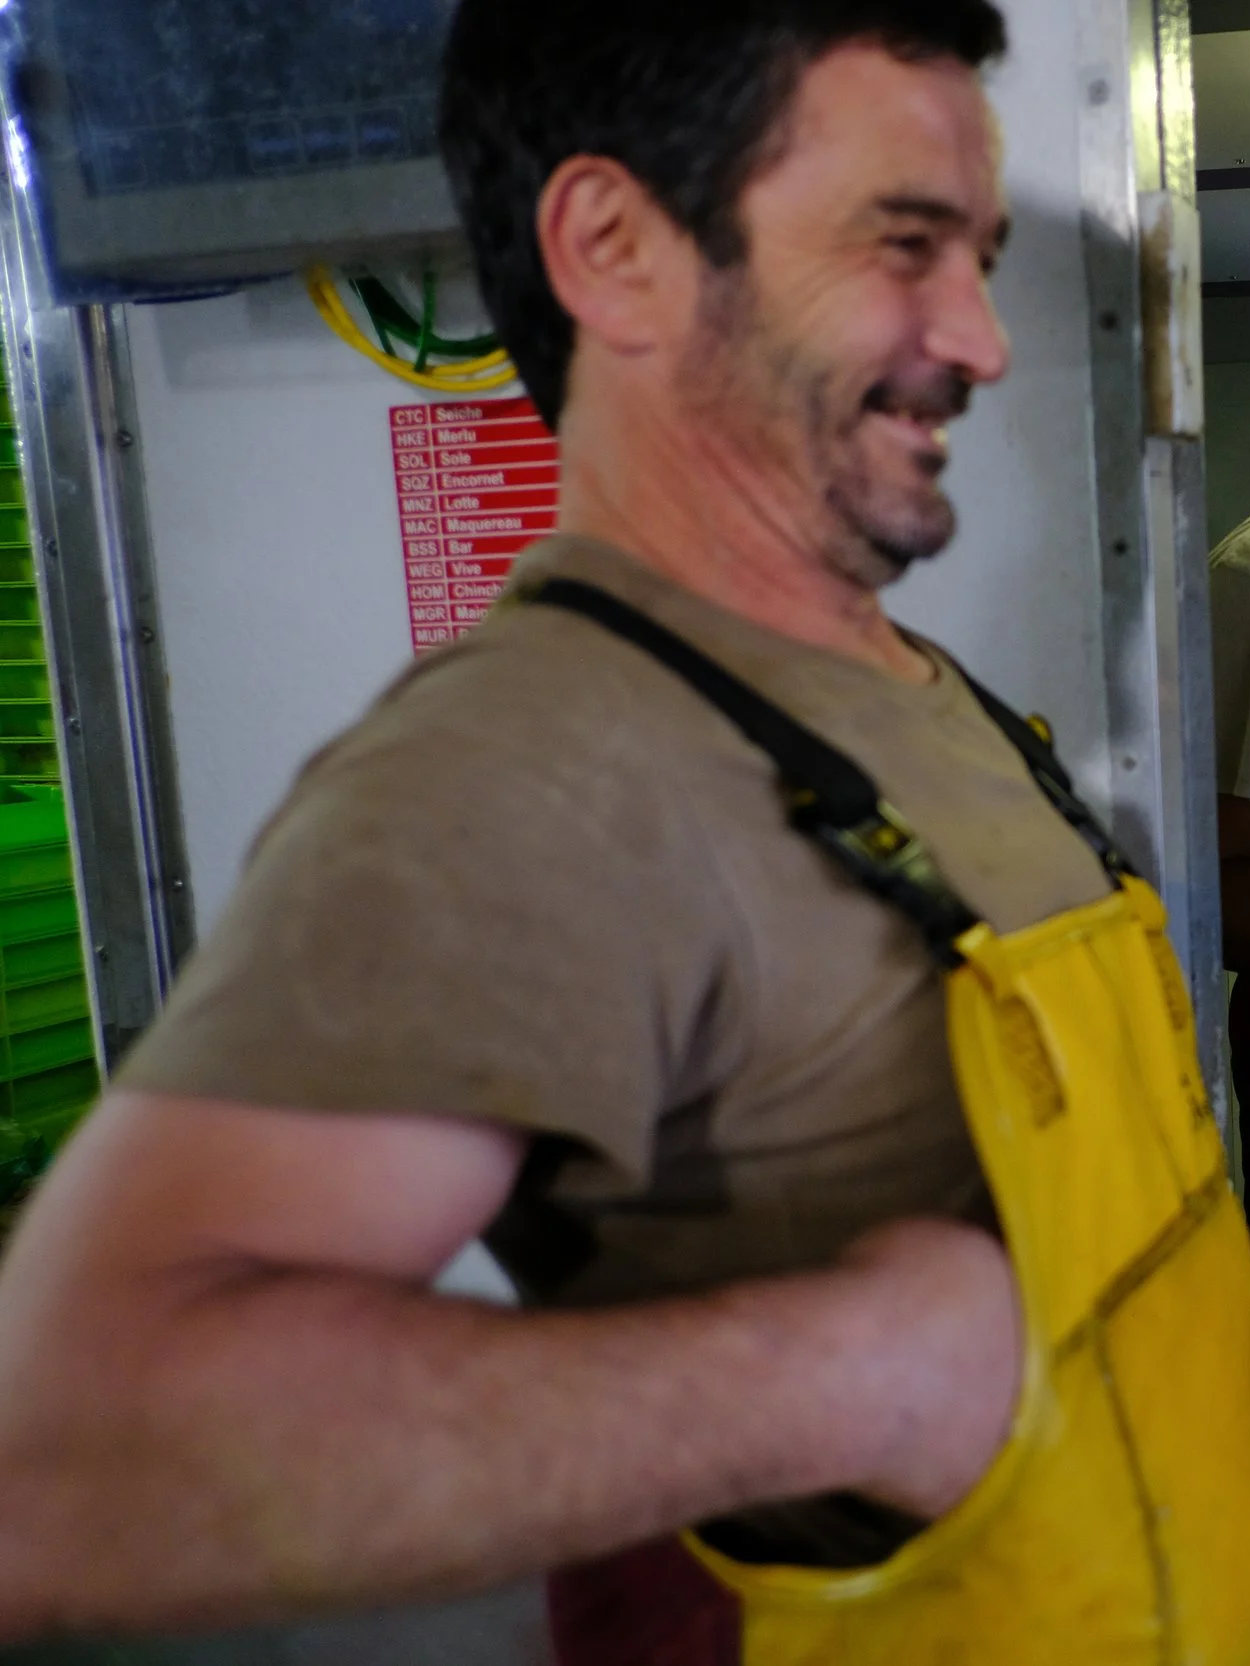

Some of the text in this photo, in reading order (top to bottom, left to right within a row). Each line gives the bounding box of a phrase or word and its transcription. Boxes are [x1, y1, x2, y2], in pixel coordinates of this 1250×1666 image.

[395, 406, 483, 425] CTC Seiche
[397, 428, 476, 447] HKE Merlu
[398, 451, 472, 470] SOL Sole
[401, 471, 505, 491] SQZ Encornet
[403, 495, 480, 513] MNZ Lotte
[405, 516, 522, 535] MAC Maquereau
[408, 539, 473, 556] BSS Bar
[410, 561, 482, 578] WEG Vive
[411, 584, 444, 600] HOM
[413, 606, 446, 621] MGR
[416, 628, 449, 644] MUR
